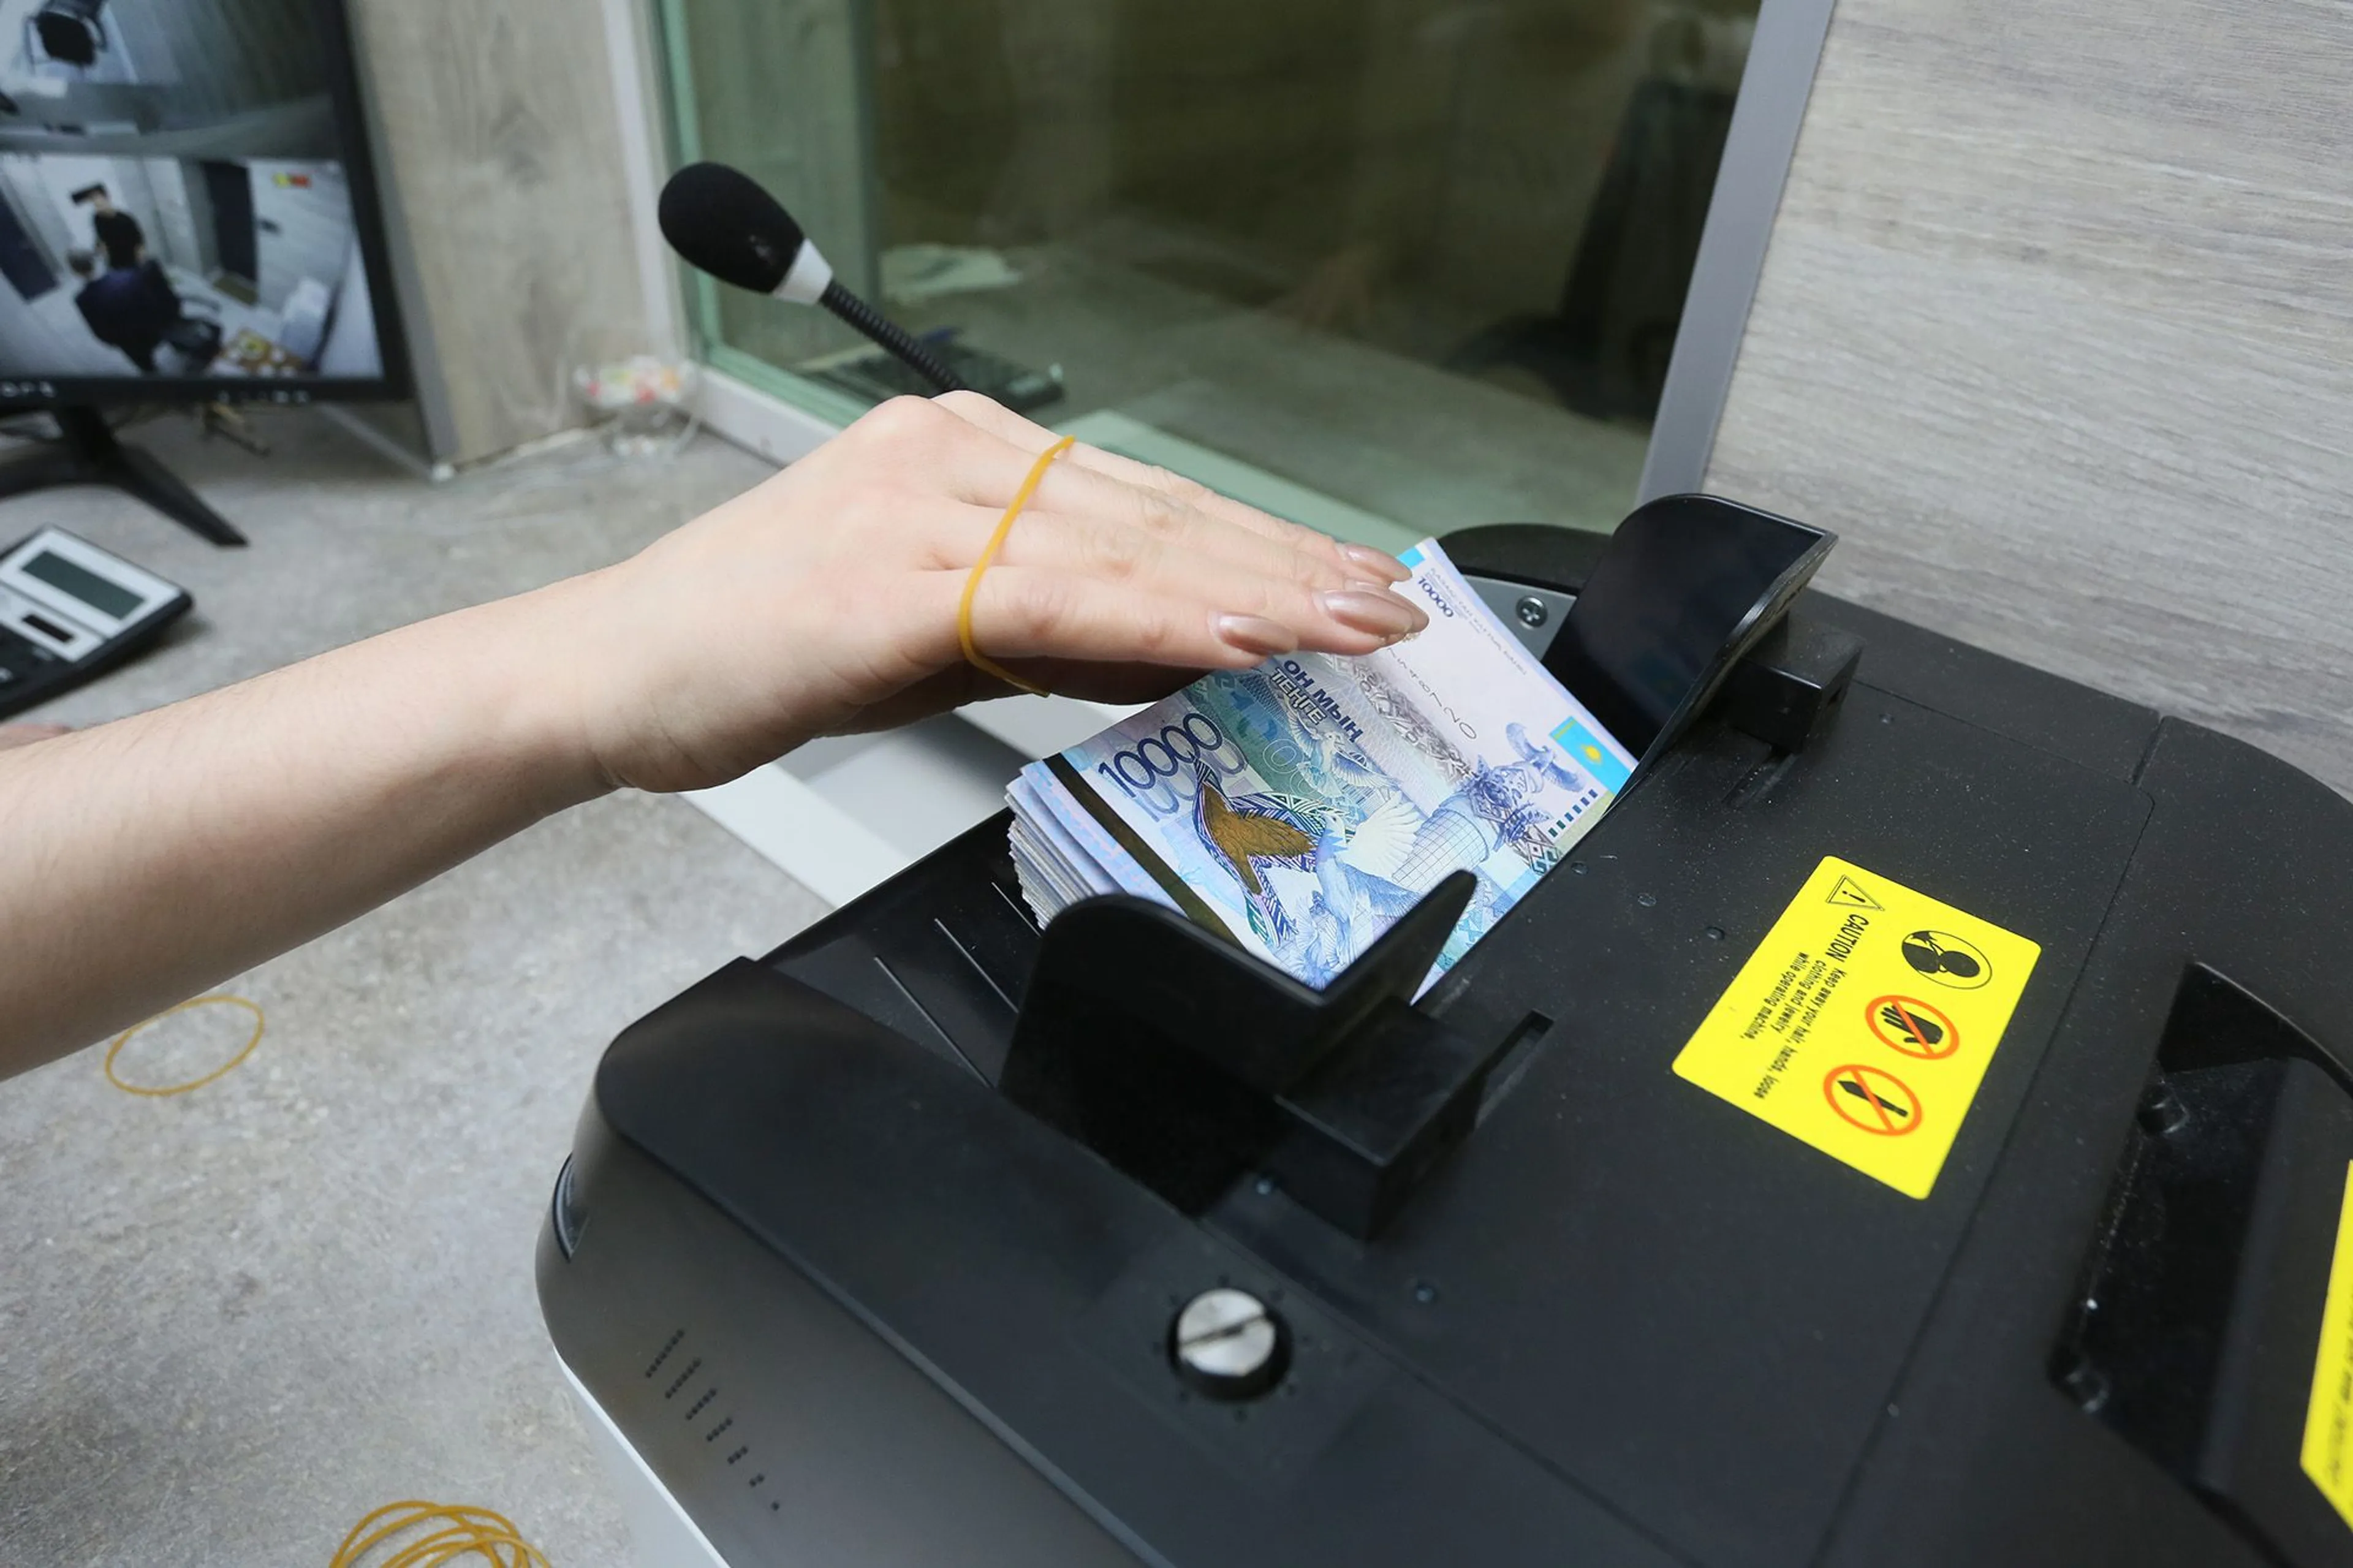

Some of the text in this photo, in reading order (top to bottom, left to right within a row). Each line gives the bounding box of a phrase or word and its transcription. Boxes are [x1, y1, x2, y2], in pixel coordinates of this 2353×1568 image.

[1417, 578, 1454, 618] 10000
[1283, 660, 1314, 687] ОН
[1270, 667, 1328, 725] ТЕҢГЕ
[1099, 713, 1223, 798] 10000
[1825, 914, 1869, 963] CAUTION
[1789, 952, 1809, 972] while
[1824, 967, 1847, 988] Keep
[1763, 971, 1797, 1007] operating
[1770, 960, 1827, 1034] clothing and jewelry
[1810, 987, 1831, 1008] away
[1800, 1006, 1819, 1027] your
[1753, 1074, 1779, 1100] loose
